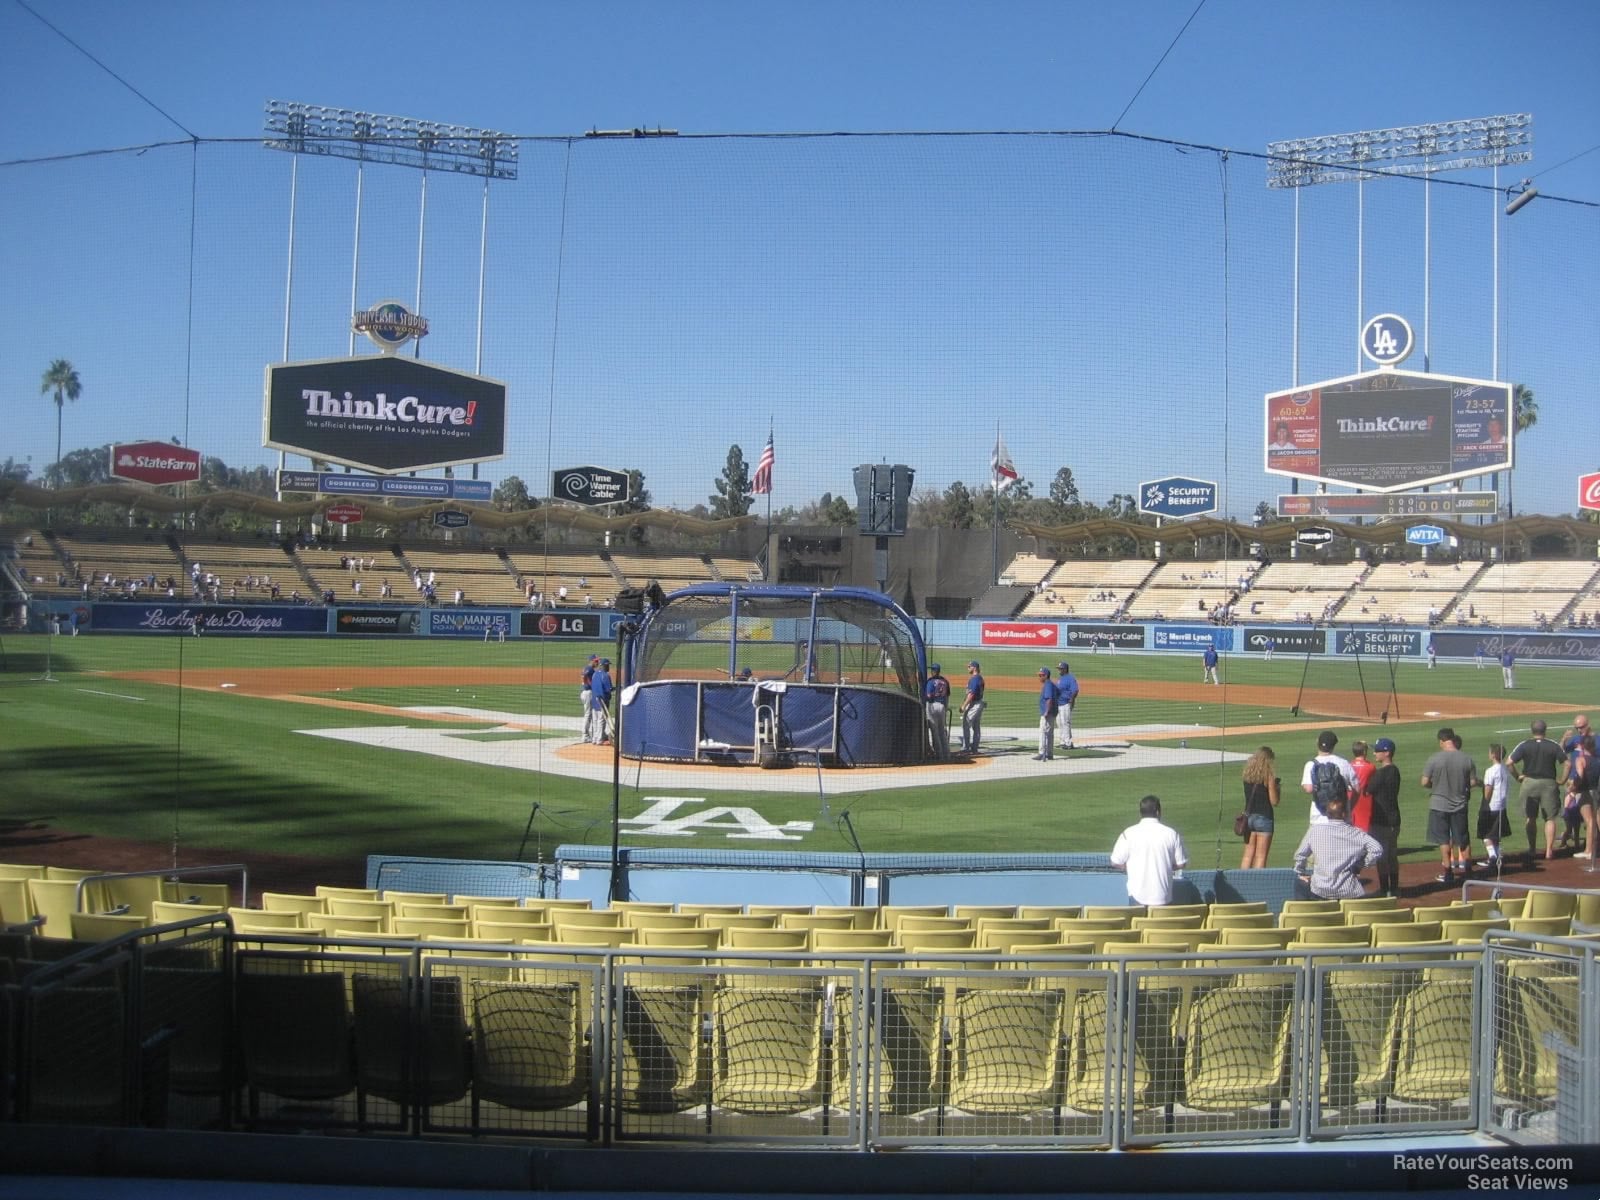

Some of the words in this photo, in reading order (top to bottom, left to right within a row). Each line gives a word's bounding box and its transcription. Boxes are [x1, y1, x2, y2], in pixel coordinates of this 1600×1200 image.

[354, 311, 398, 325] UNIVERSAL
[366, 324, 420, 335] HOLLYWOOD
[1373, 323, 1397, 355] LA
[302, 389, 477, 426] ThinkCure!
[1465, 399, 1495, 409] 73-57
[1279, 406, 1307, 416] 60-69
[306, 420, 318, 428] the
[320, 421, 346, 430] official
[348, 422, 374, 432] charity
[375, 423, 383, 431] of
[385, 424, 396, 432] the
[397, 425, 410, 433] Los
[411, 427, 440, 436] Angeles
[441, 428, 471, 438] Dodgers
[1336, 415, 1436, 433] ThinkCure!
[590, 473, 612, 483] Time
[590, 481, 621, 491] Warner
[1168, 486, 1212, 496] SECURITY
[589, 489, 612, 499] Cable
[1168, 496, 1206, 505] BENEFIT
[1455, 499, 1494, 508] SUBWAY
[1419, 501, 1426, 511] 0
[1431, 501, 1438, 511] 0
[1443, 501, 1451, 511] 0
[1409, 530, 1440, 540] AVITA
[139, 608, 167, 628] Los
[166, 609, 222, 633] Angles
[223, 610, 283, 633] Dodgers
[432, 615, 455, 625] SAN
[464, 615, 509, 626] MANUEL
[562, 618, 584, 632] LG
[1121, 632, 1142, 641] Cable
[1169, 633, 1192, 641] Merrill
[1192, 633, 1213, 642] Lynch
[1364, 632, 1415, 643] SECURITY
[1482, 636, 1502, 656] Los
[1501, 637, 1562, 658] Angeles
[610, 796, 815, 841] LA
